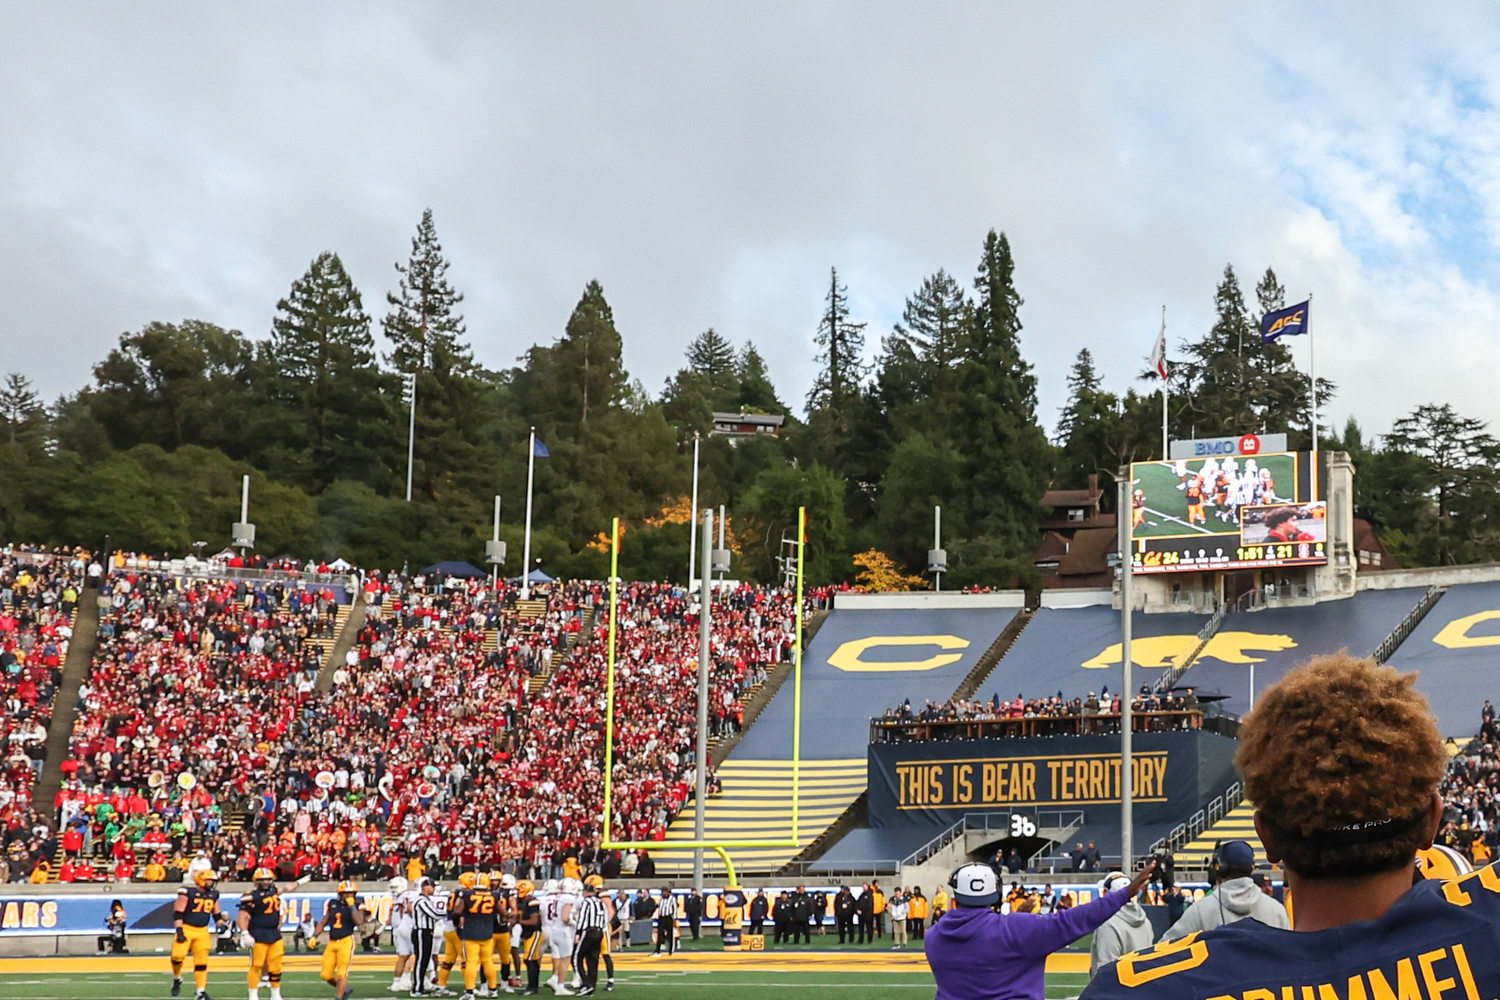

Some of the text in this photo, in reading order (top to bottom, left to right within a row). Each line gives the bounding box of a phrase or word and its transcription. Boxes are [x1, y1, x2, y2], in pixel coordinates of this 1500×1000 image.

[1195, 441, 1235, 456] BMO
[1236, 546, 1264, 560] 1:51
[1276, 545, 1292, 558] 21
[896, 757, 1168, 805] THIS IS BEAR TERRITORY
[1010, 814, 1036, 837] 36
[970, 879, 984, 892] C
[468, 895, 495, 914] 72
[724, 912, 738, 924] Cal
